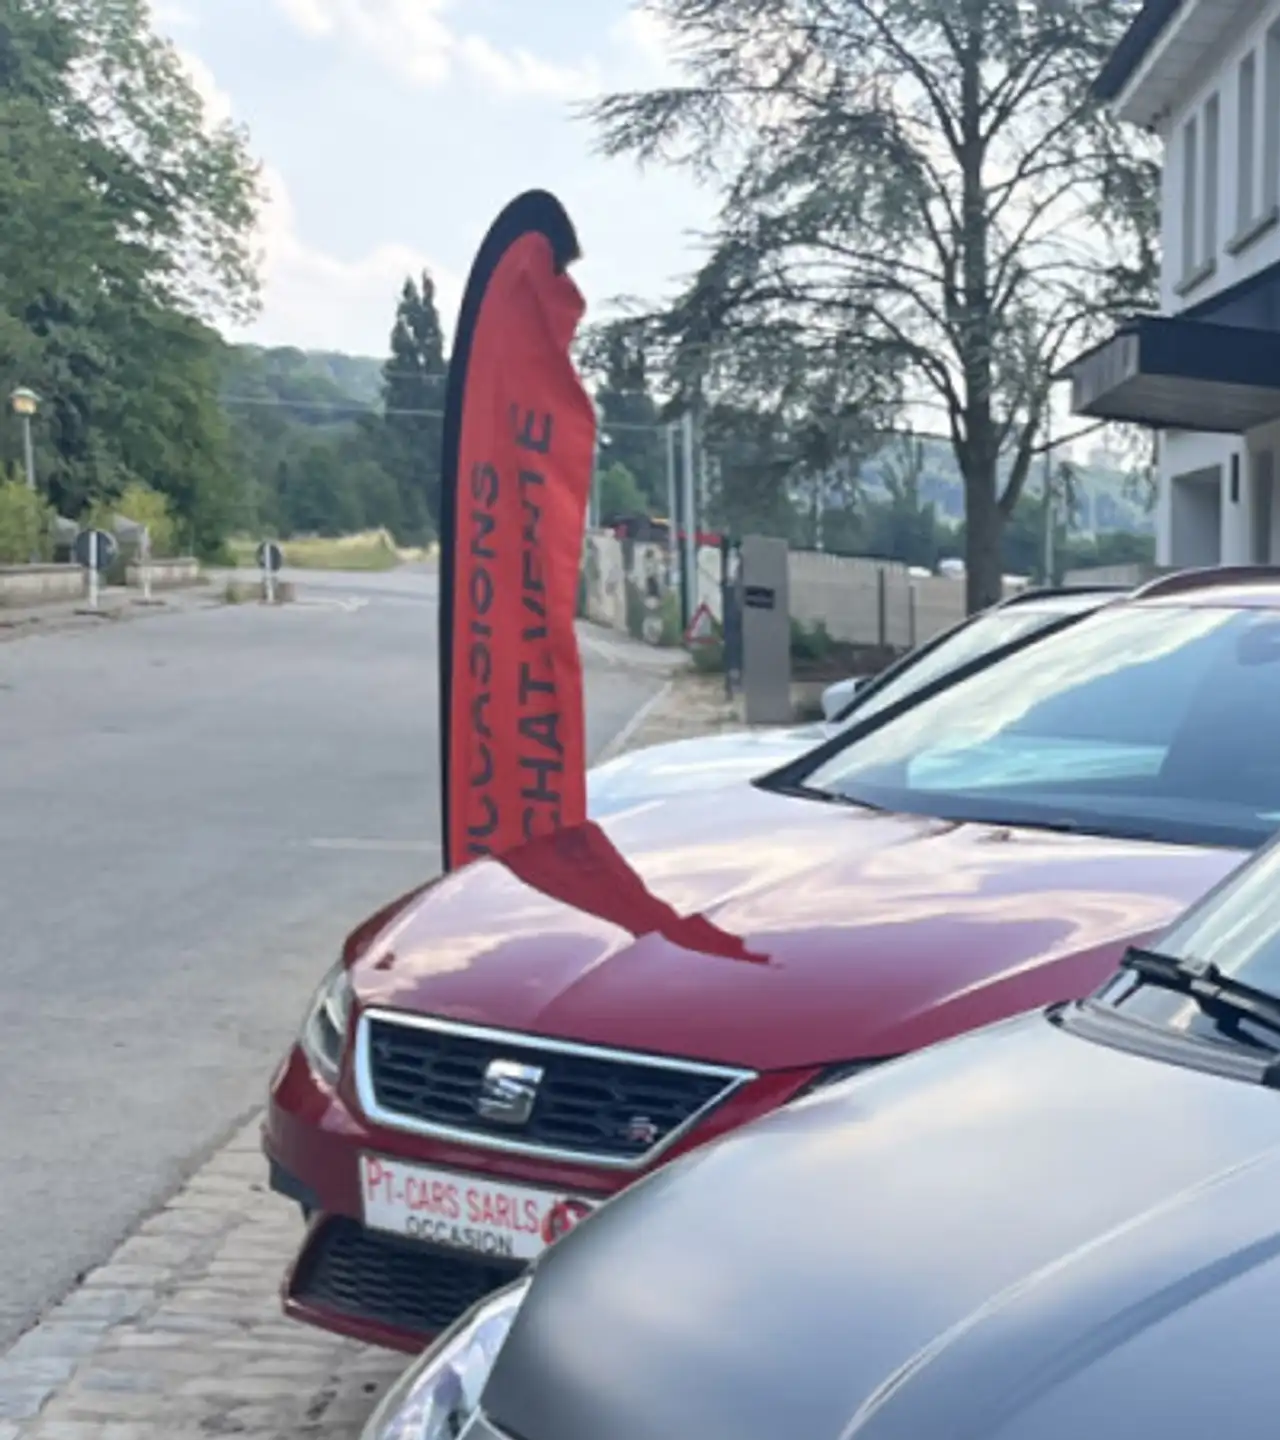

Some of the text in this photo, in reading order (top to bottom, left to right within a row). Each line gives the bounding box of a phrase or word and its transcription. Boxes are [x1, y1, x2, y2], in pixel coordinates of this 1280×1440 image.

[365, 1157, 540, 1234] PT-CARS SARLS
[405, 1215, 514, 1255] OCCASION
